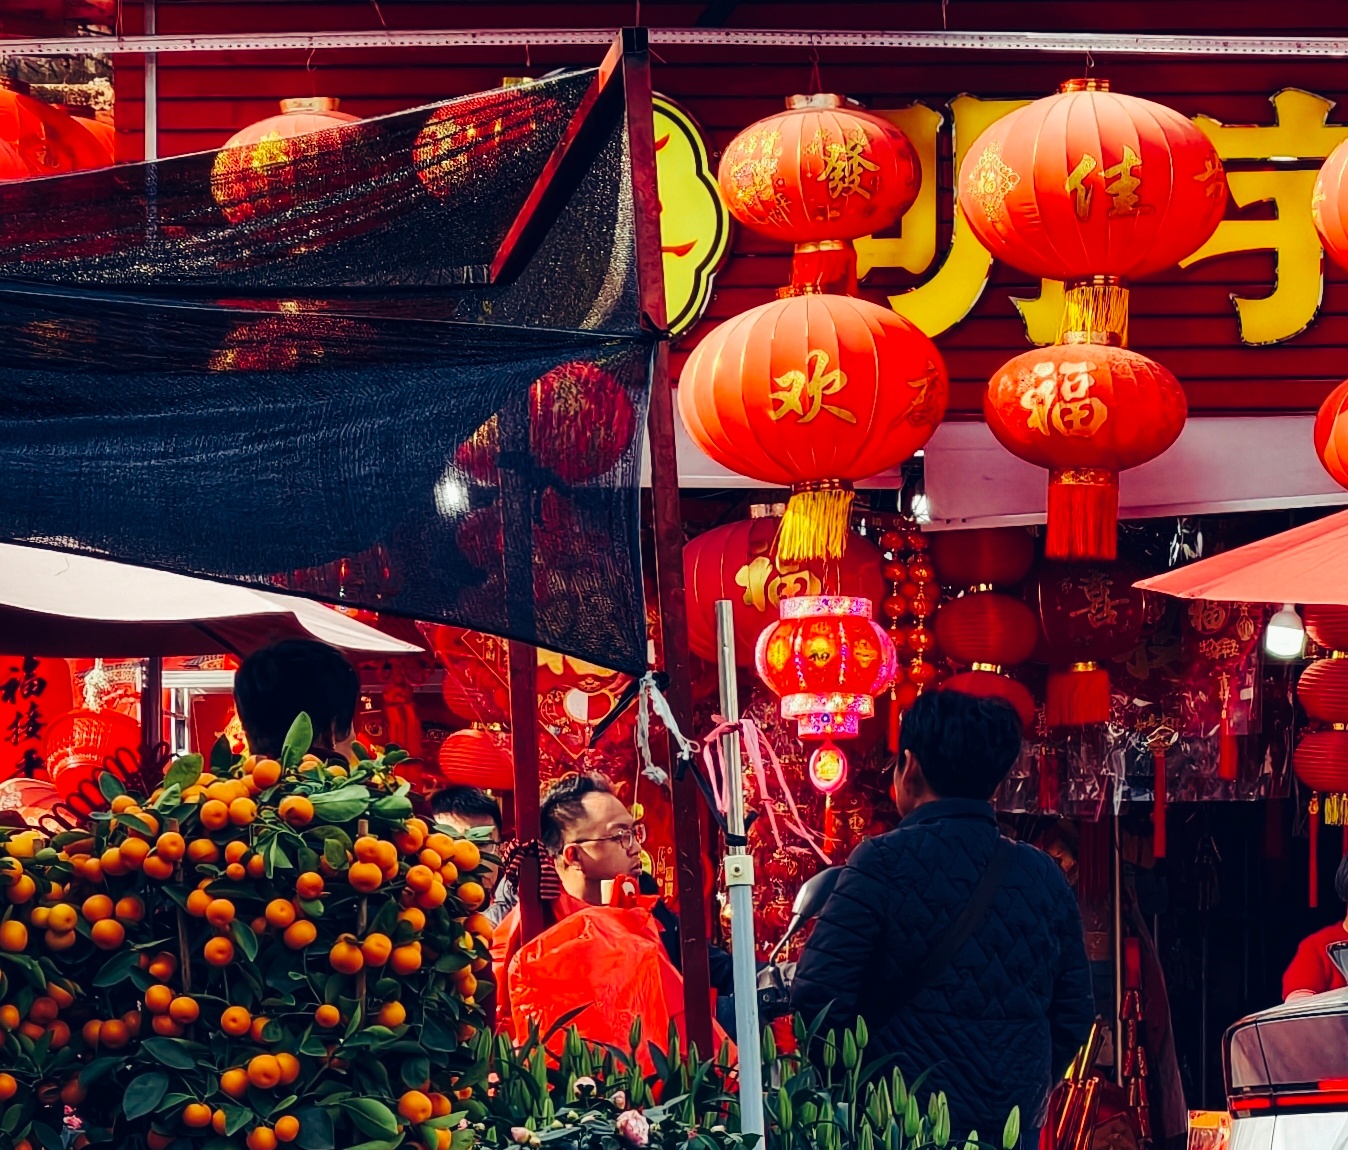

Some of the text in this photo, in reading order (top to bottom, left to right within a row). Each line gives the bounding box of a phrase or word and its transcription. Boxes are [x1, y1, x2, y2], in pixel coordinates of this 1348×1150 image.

[1064, 143, 1155, 220] 佳
[768, 348, 857, 424] 欢
[1020, 361, 1108, 438] 福
